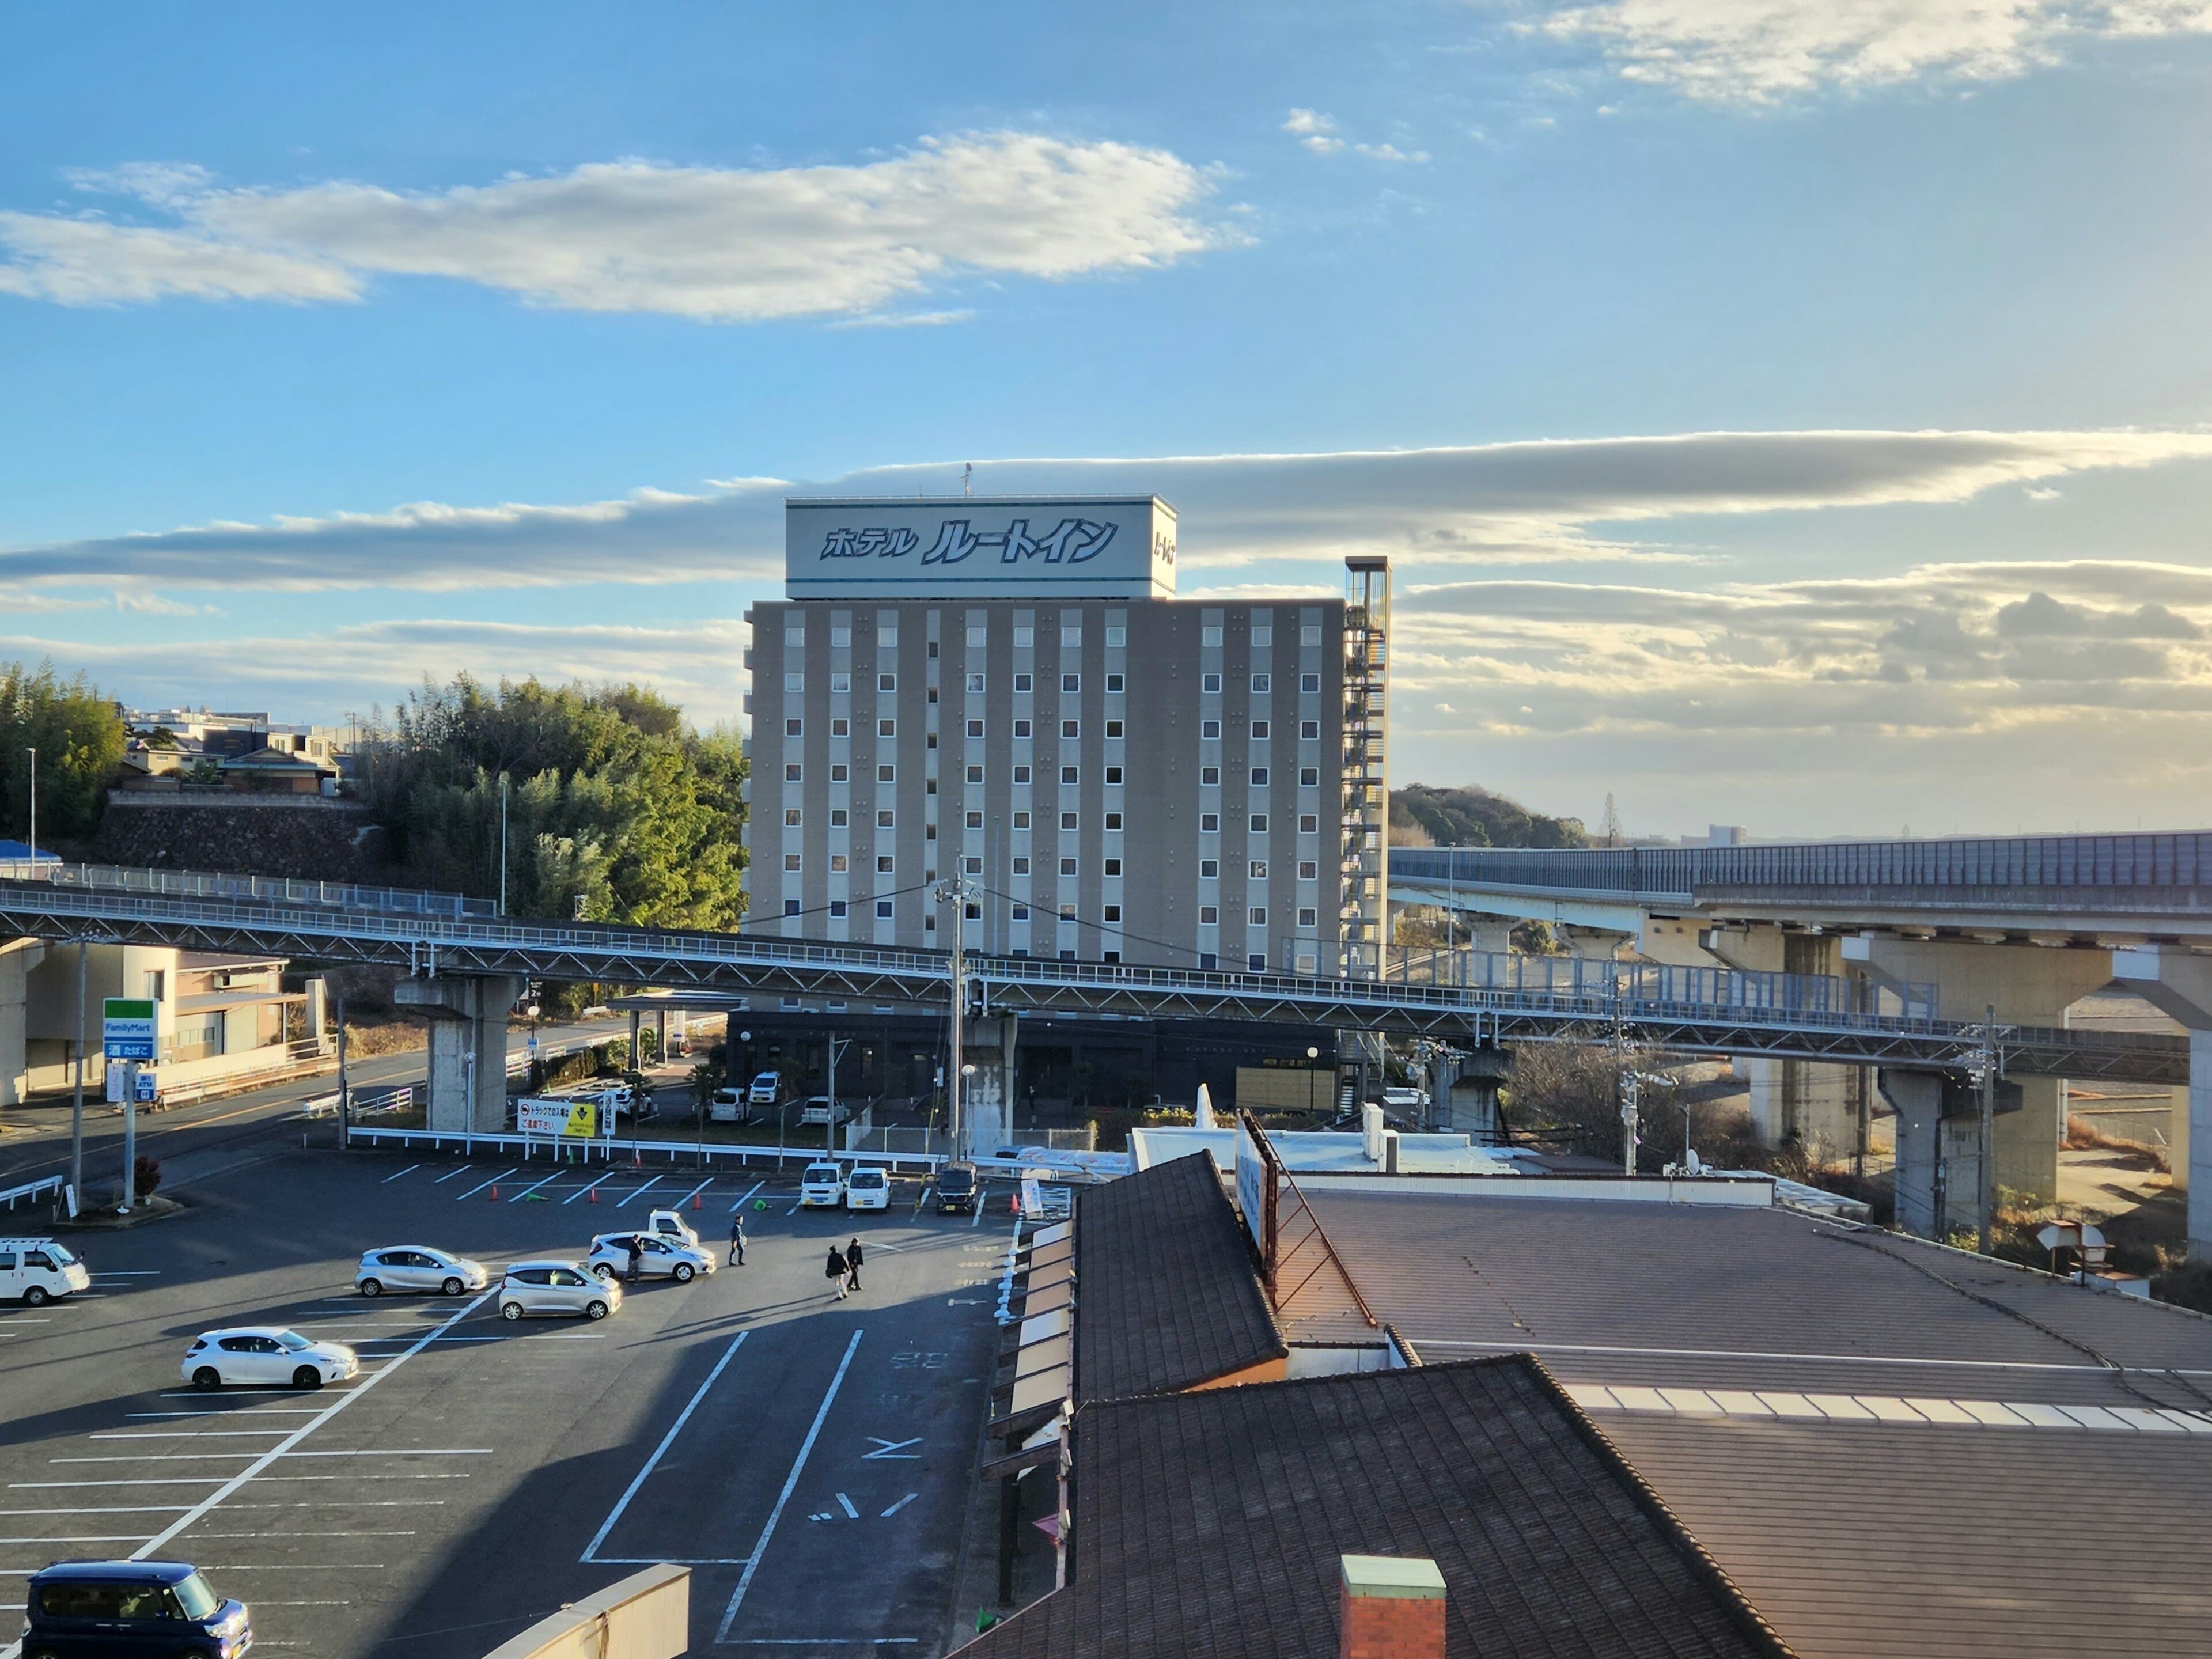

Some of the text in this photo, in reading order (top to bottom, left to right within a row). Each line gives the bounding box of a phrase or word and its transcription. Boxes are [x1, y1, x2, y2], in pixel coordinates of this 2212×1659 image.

[819, 517, 1119, 566] ホテル ルートイン
[106, 1023, 150, 1033] FamilyMart
[124, 1046, 147, 1055] たばこ
